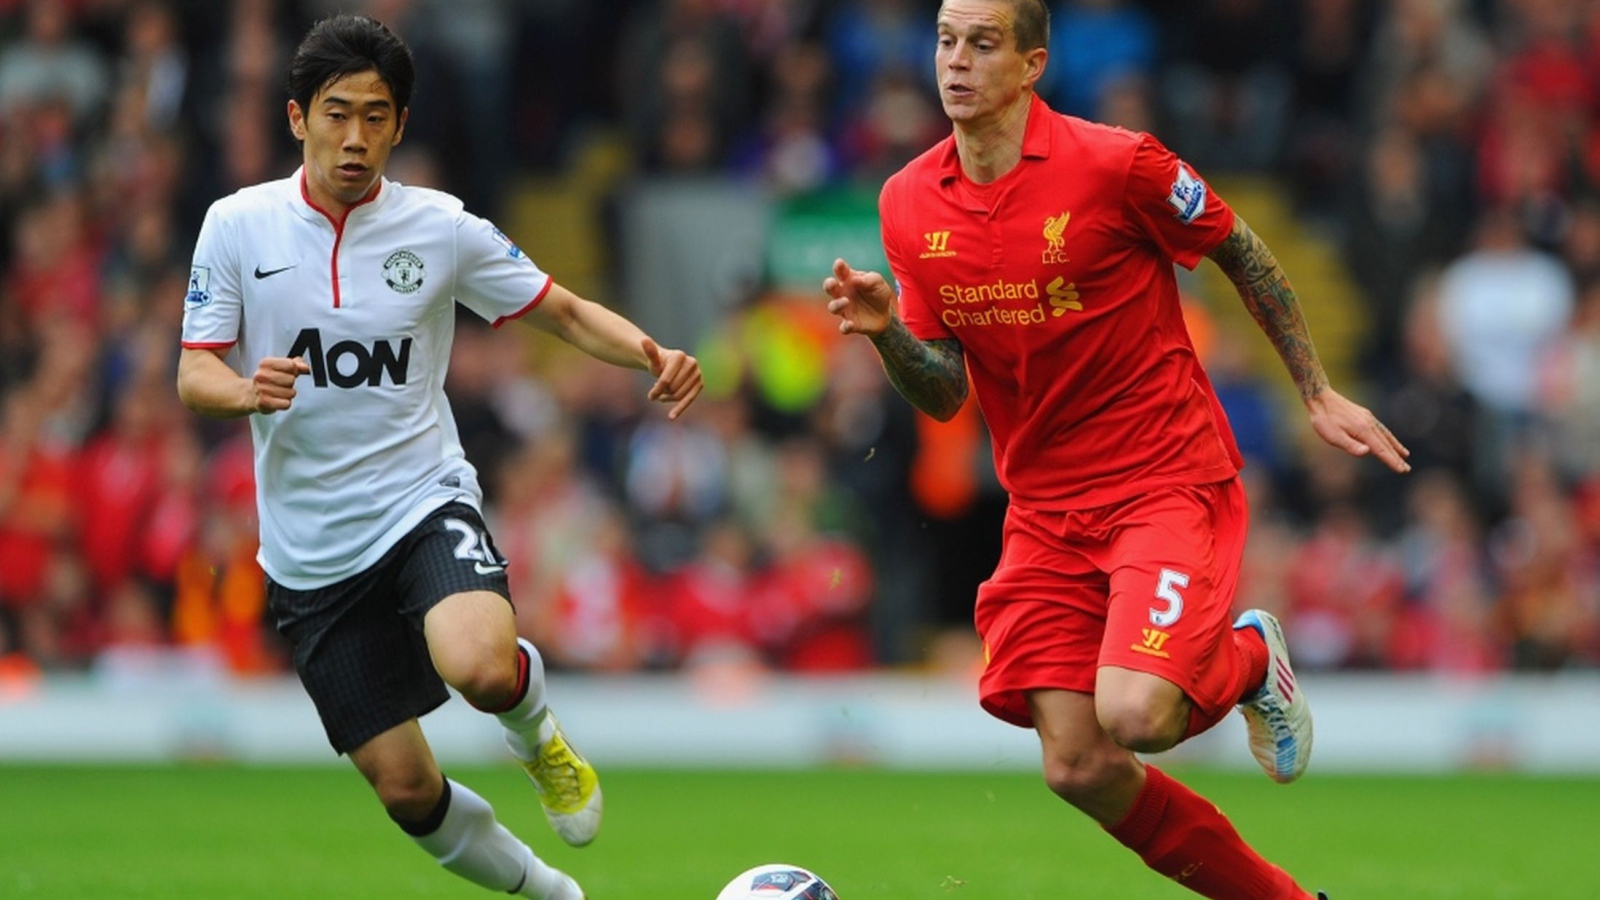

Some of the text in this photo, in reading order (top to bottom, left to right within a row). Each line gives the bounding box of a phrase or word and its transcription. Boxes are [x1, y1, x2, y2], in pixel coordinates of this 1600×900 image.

[939, 279, 1039, 305] Standard
[942, 302, 1045, 328] Chartered
[286, 328, 413, 389] AON
[1149, 567, 1189, 627] 5
